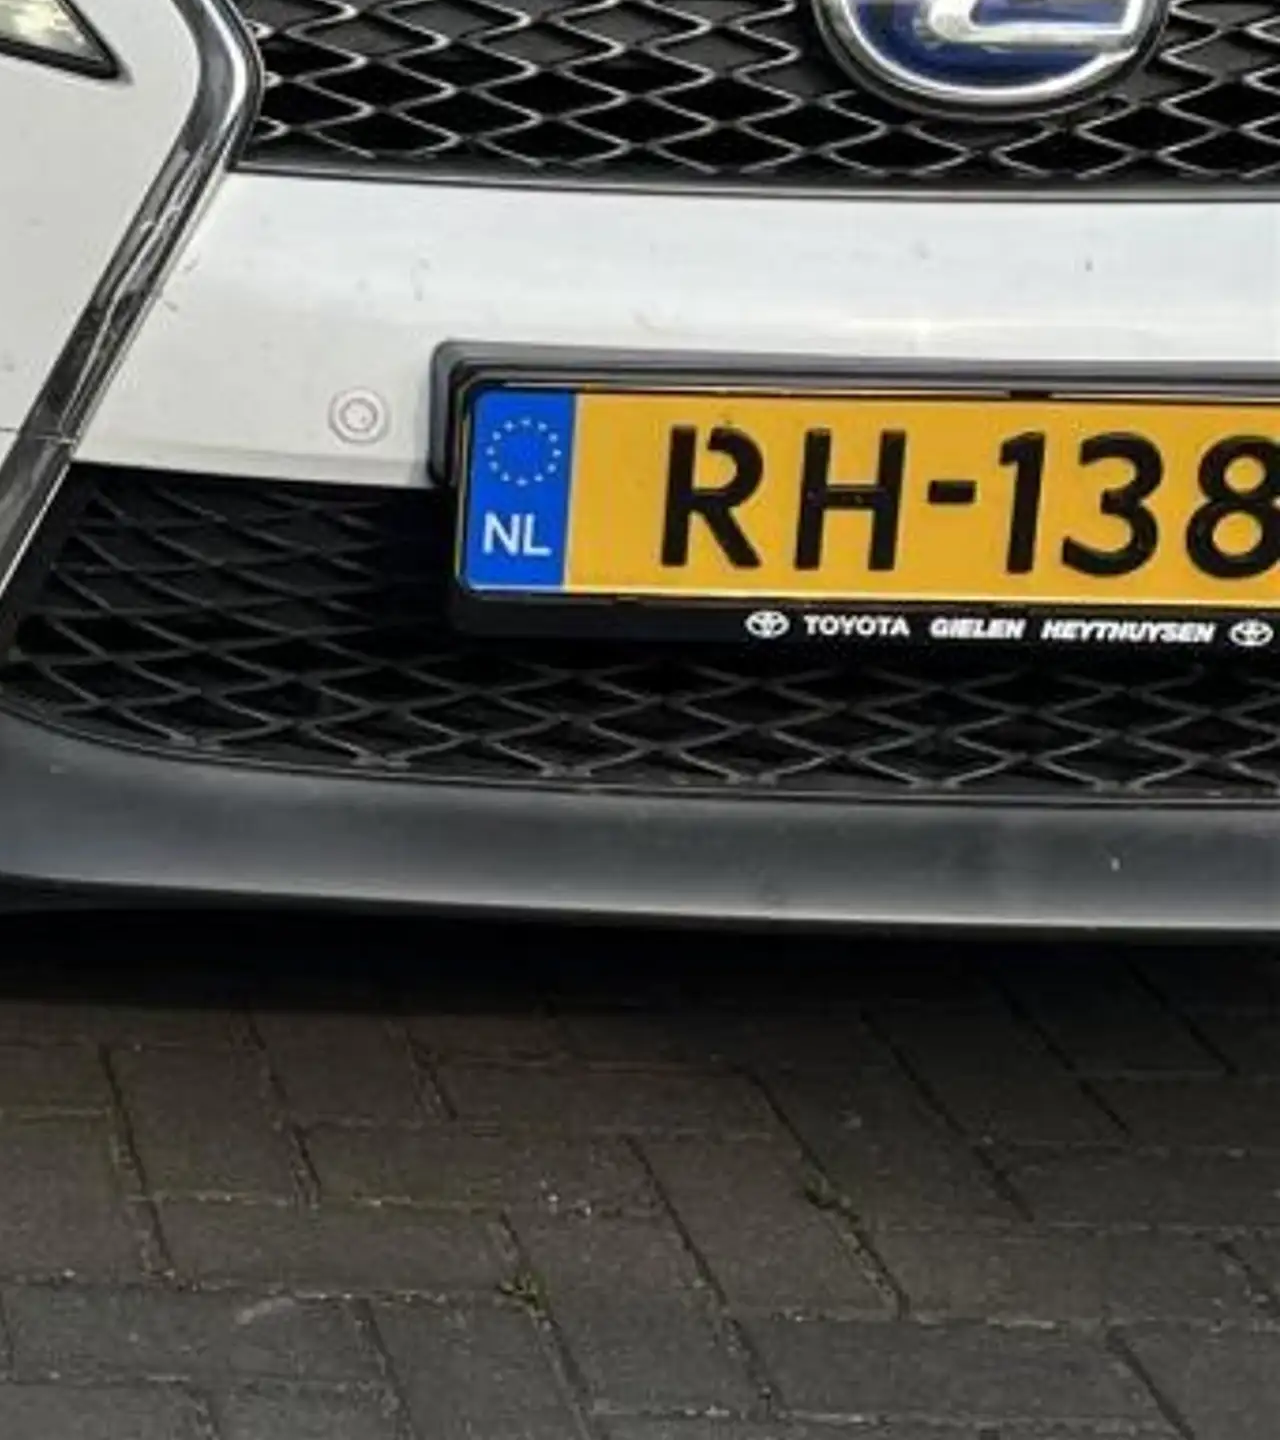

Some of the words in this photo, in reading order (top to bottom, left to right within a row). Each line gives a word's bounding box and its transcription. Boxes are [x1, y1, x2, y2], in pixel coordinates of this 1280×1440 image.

[659, 426, 1280, 582] RH-138
[480, 513, 551, 559] NL
[803, 613, 912, 638] TOYOTA
[928, 616, 1027, 641] GIELEN
